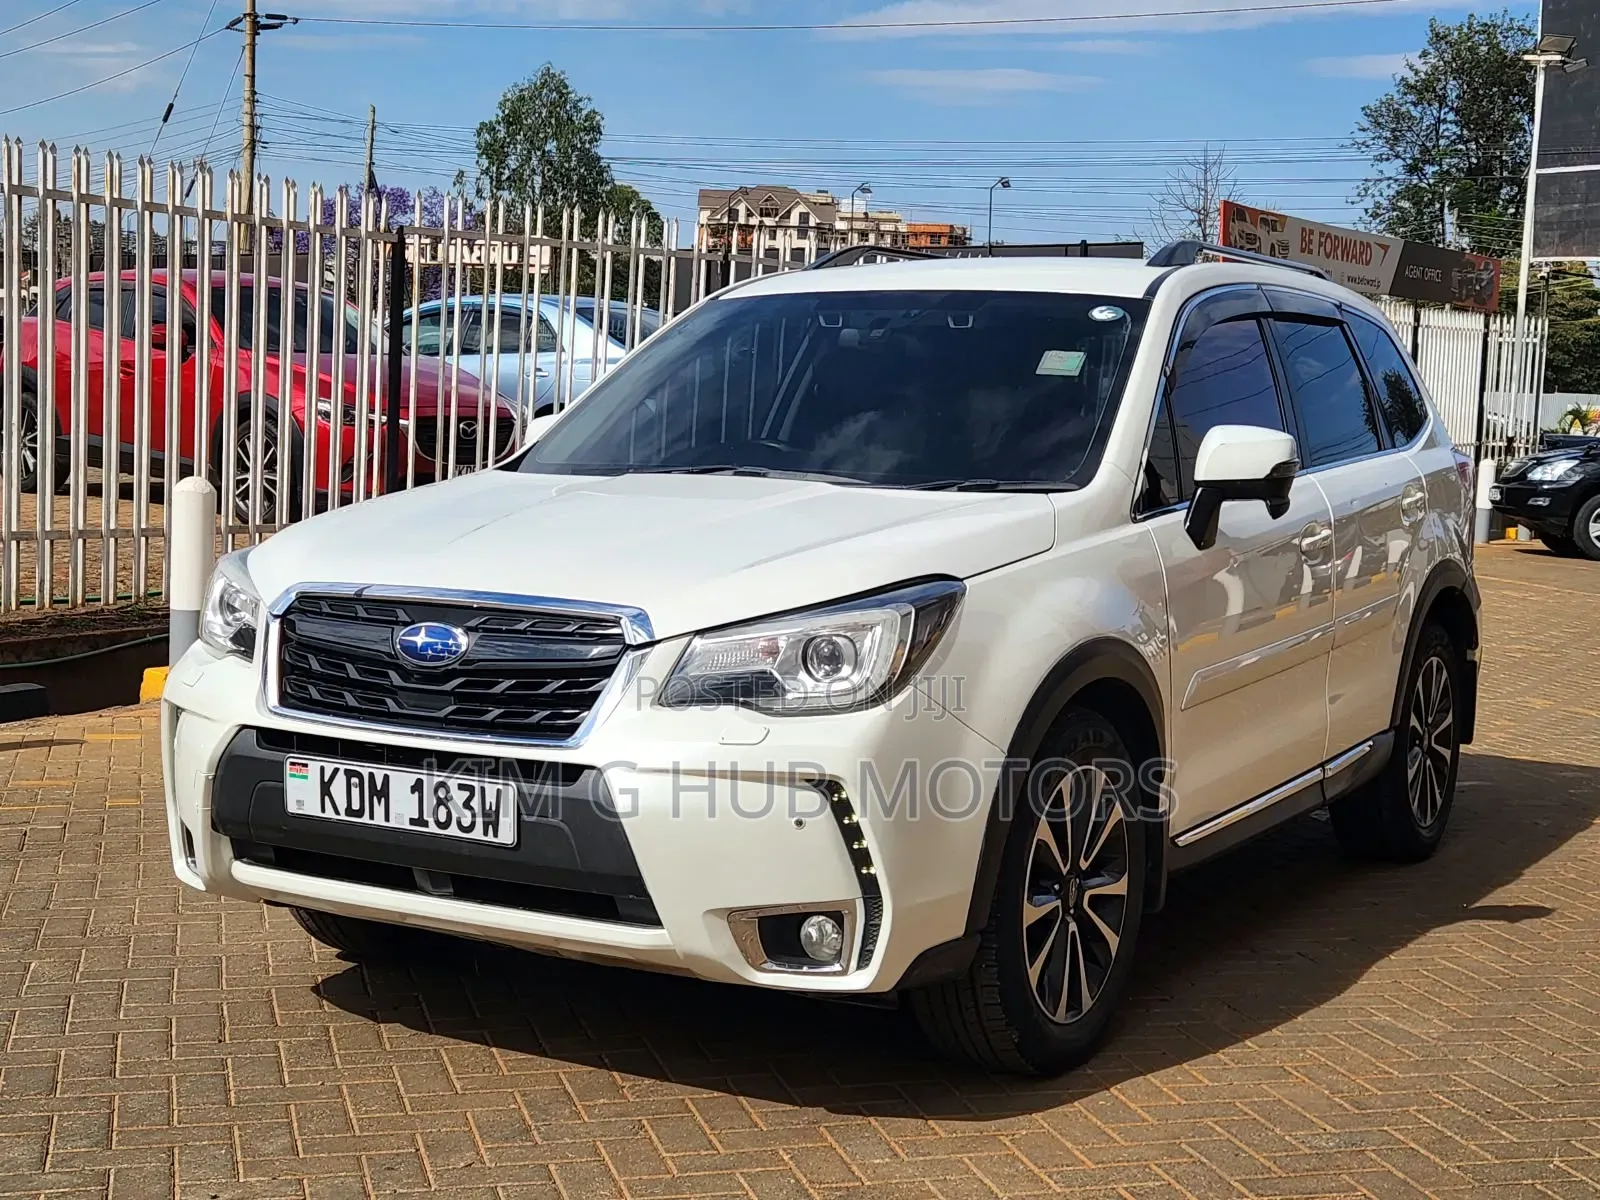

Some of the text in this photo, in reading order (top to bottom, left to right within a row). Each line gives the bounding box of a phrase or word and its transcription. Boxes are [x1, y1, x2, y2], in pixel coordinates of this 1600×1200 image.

[1300, 226, 1373, 267] BE FORWARD
[1404, 264, 1442, 282] AGENT OFFICE
[319, 764, 503, 839] KDM 183W
